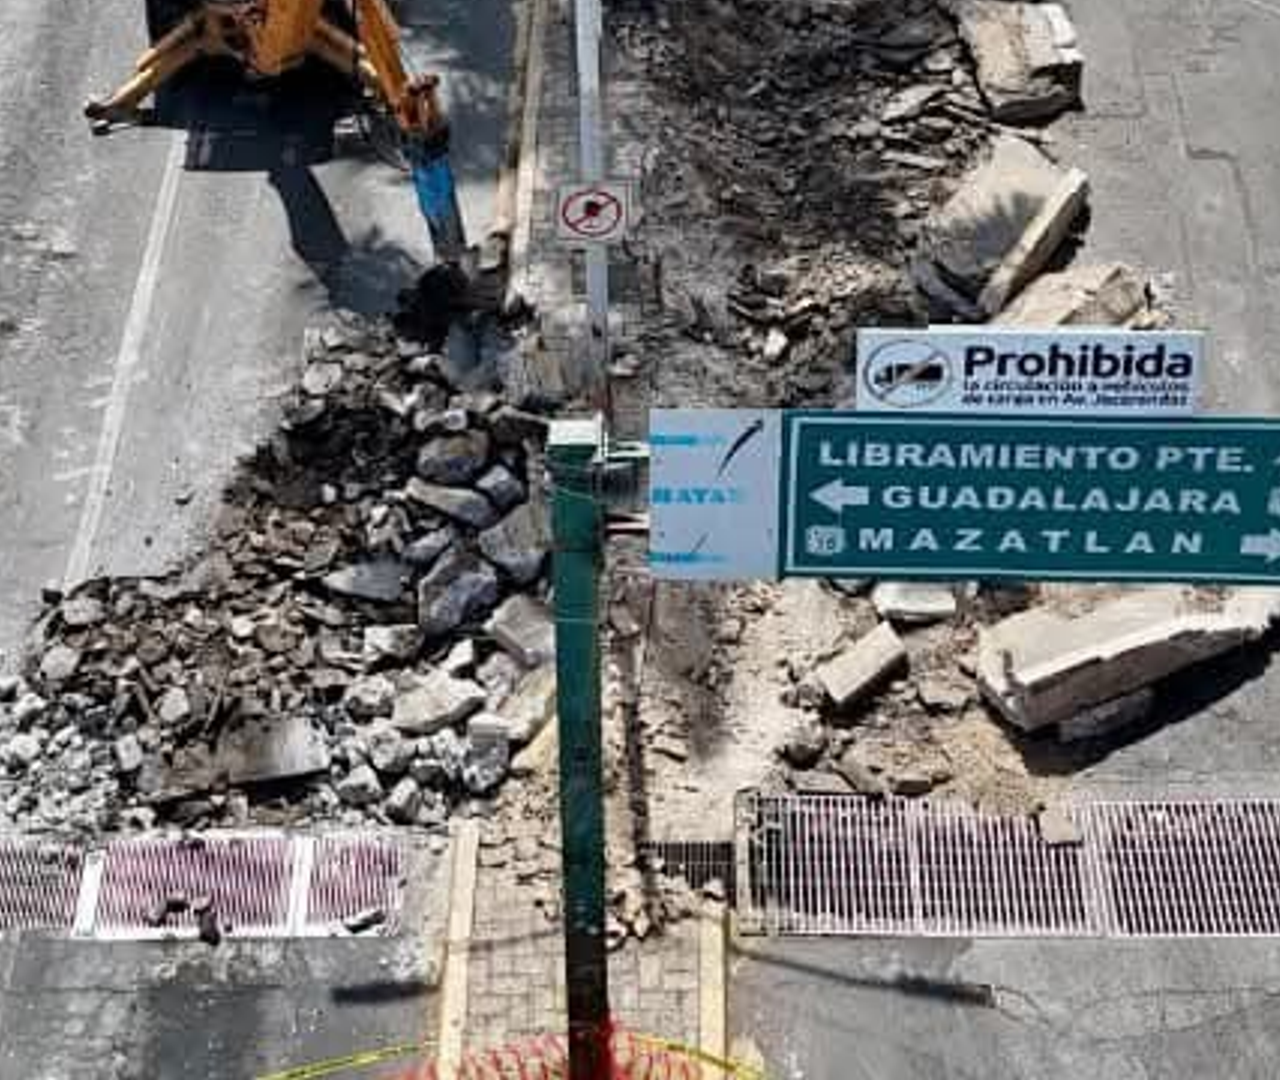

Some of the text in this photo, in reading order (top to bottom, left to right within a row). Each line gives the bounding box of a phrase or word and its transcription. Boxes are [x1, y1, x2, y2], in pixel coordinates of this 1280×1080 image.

[963, 344, 1193, 378] Prohibida
[820, 442, 1255, 472] LIBRAMIENTO PTE.
[881, 485, 1242, 514] GUADALAJARA
[858, 527, 1203, 554] MAZATLAN
